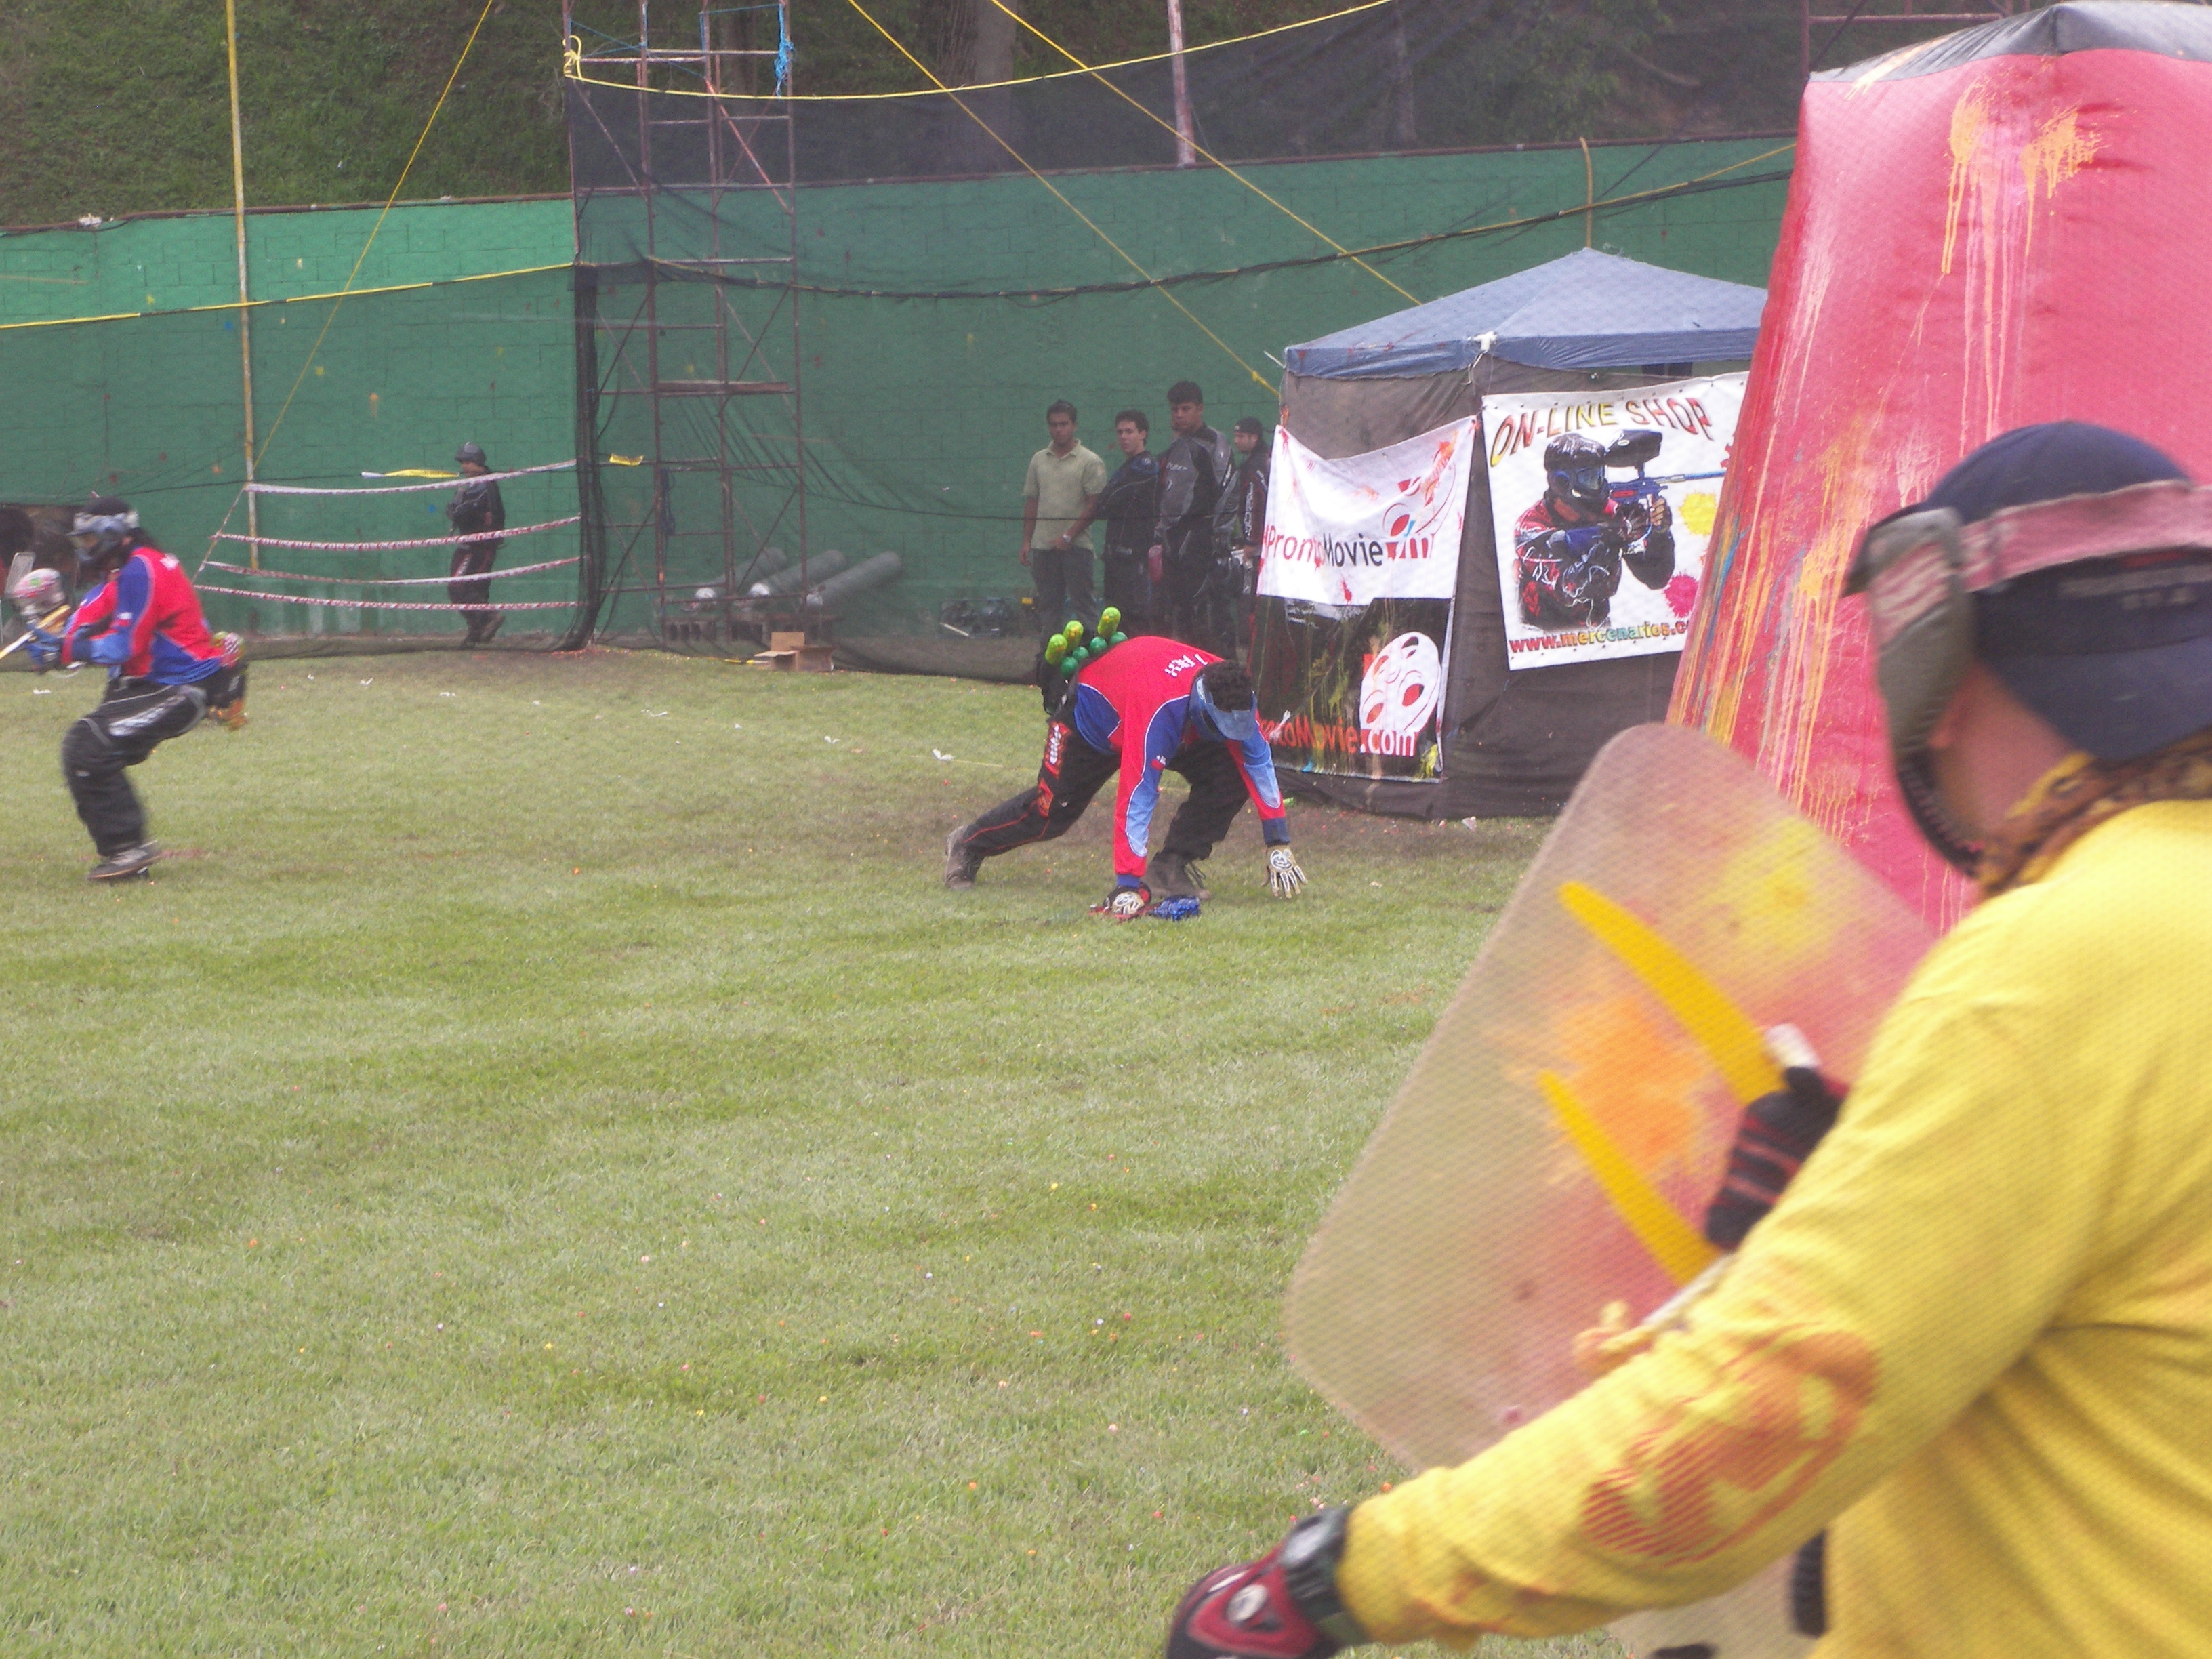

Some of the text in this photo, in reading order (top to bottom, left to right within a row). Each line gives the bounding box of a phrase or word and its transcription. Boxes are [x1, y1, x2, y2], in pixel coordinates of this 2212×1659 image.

[1490, 398, 1715, 468] ON-LINE SHOP
[1509, 620, 1689, 653] www.mercenarios.c
